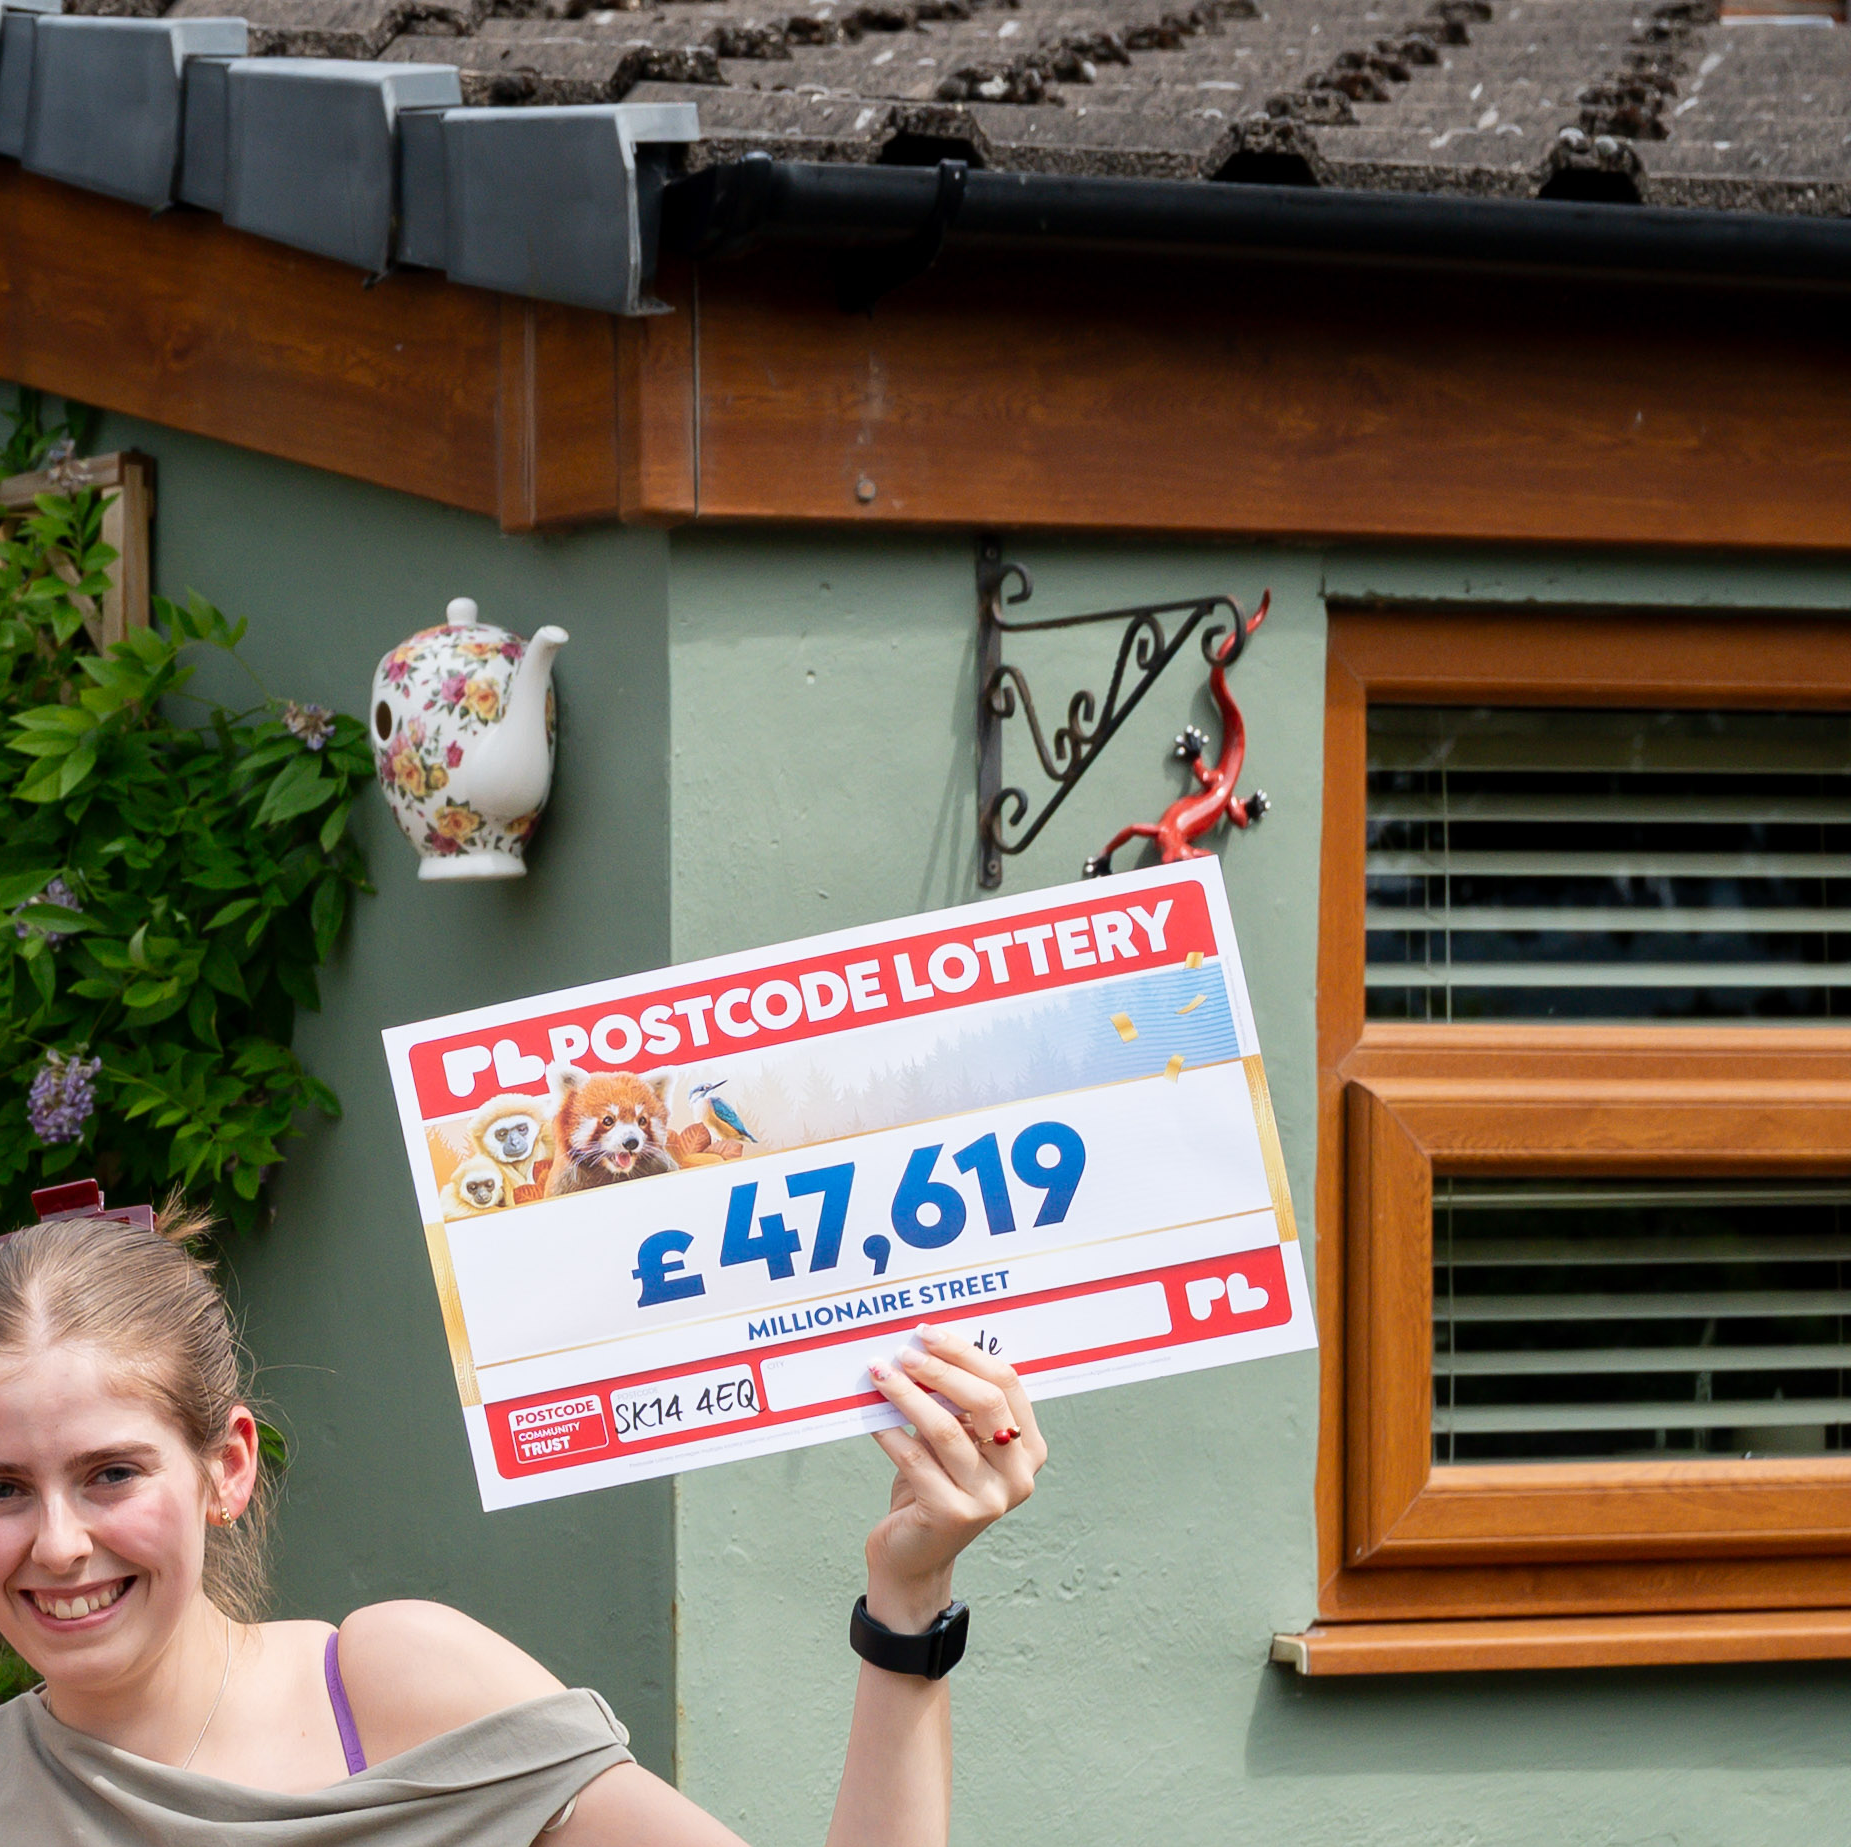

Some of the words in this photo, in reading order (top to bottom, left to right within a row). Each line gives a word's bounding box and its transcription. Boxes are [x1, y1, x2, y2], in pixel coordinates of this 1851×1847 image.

[548, 958, 889, 1066] POSTCODE
[893, 899, 1174, 1003] LOTTERY
[748, 1289, 915, 1342] MILLIONAIRE
[918, 1269, 1010, 1306] STREET
[515, 1399, 596, 1427] POSTCODE
[615, 1394, 683, 1434] SK14
[696, 1378, 766, 1414] 4EQ
[518, 1421, 581, 1443] COMMUNITY
[521, 1435, 571, 1458] TRUST
